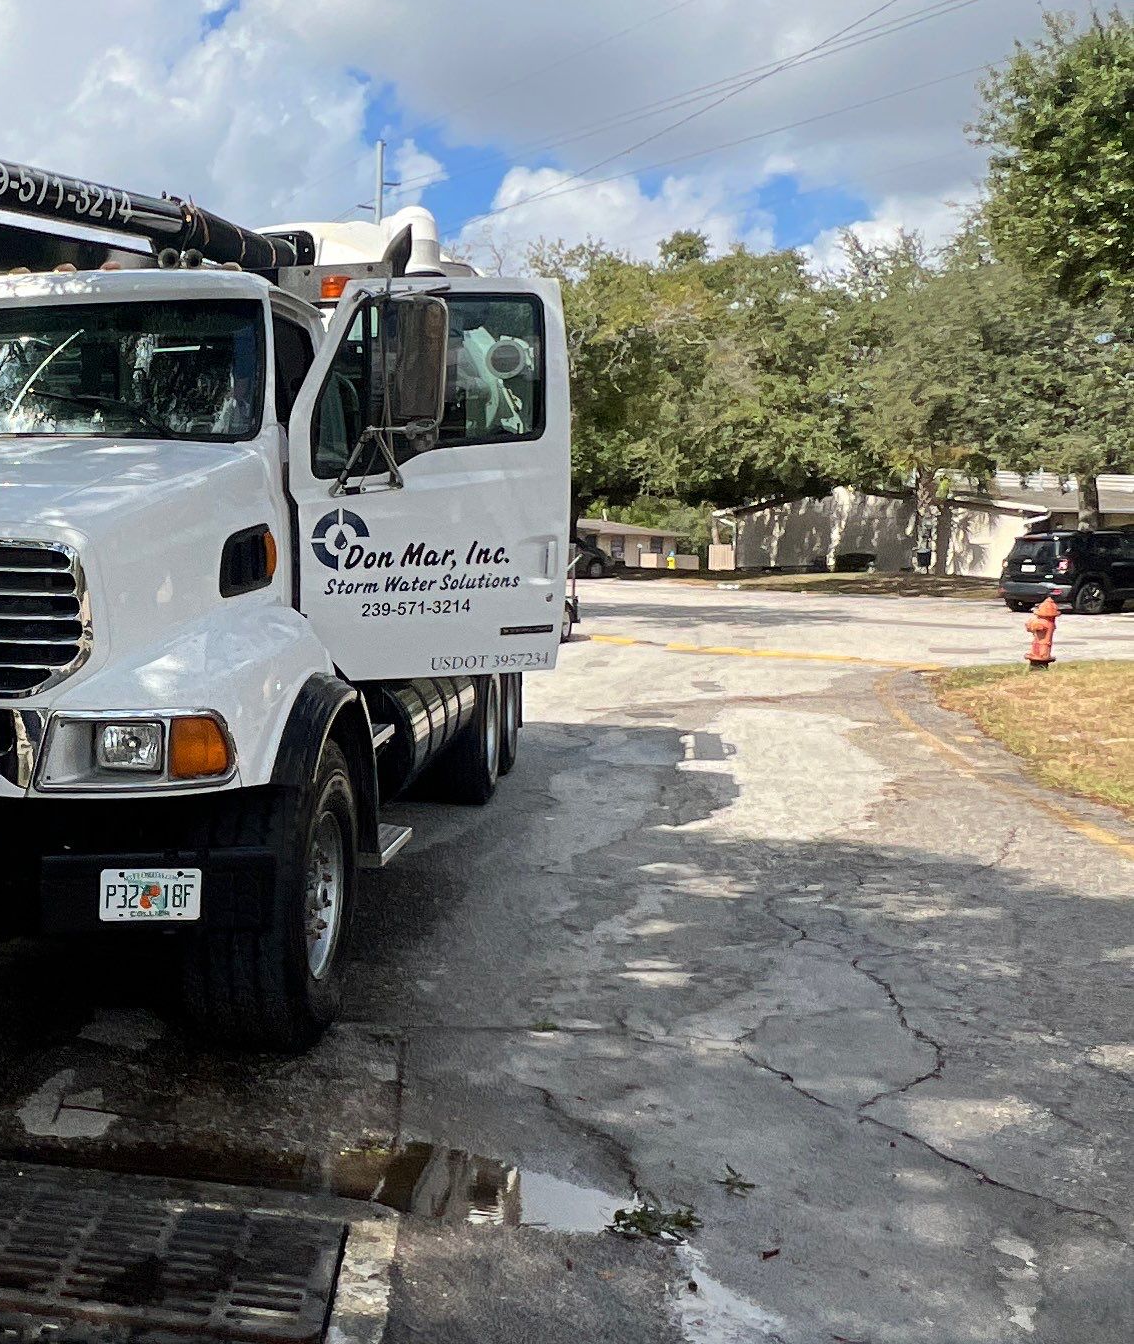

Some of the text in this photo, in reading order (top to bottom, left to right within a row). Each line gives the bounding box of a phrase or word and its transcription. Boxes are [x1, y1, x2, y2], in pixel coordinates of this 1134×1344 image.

[344, 541, 510, 570] Don Mar, Inc.
[324, 573, 520, 595] Storm Water Solutions
[361, 599, 471, 617] 239-571-3214
[431, 655, 488, 671] USDOT
[106, 885, 139, 908] P32
